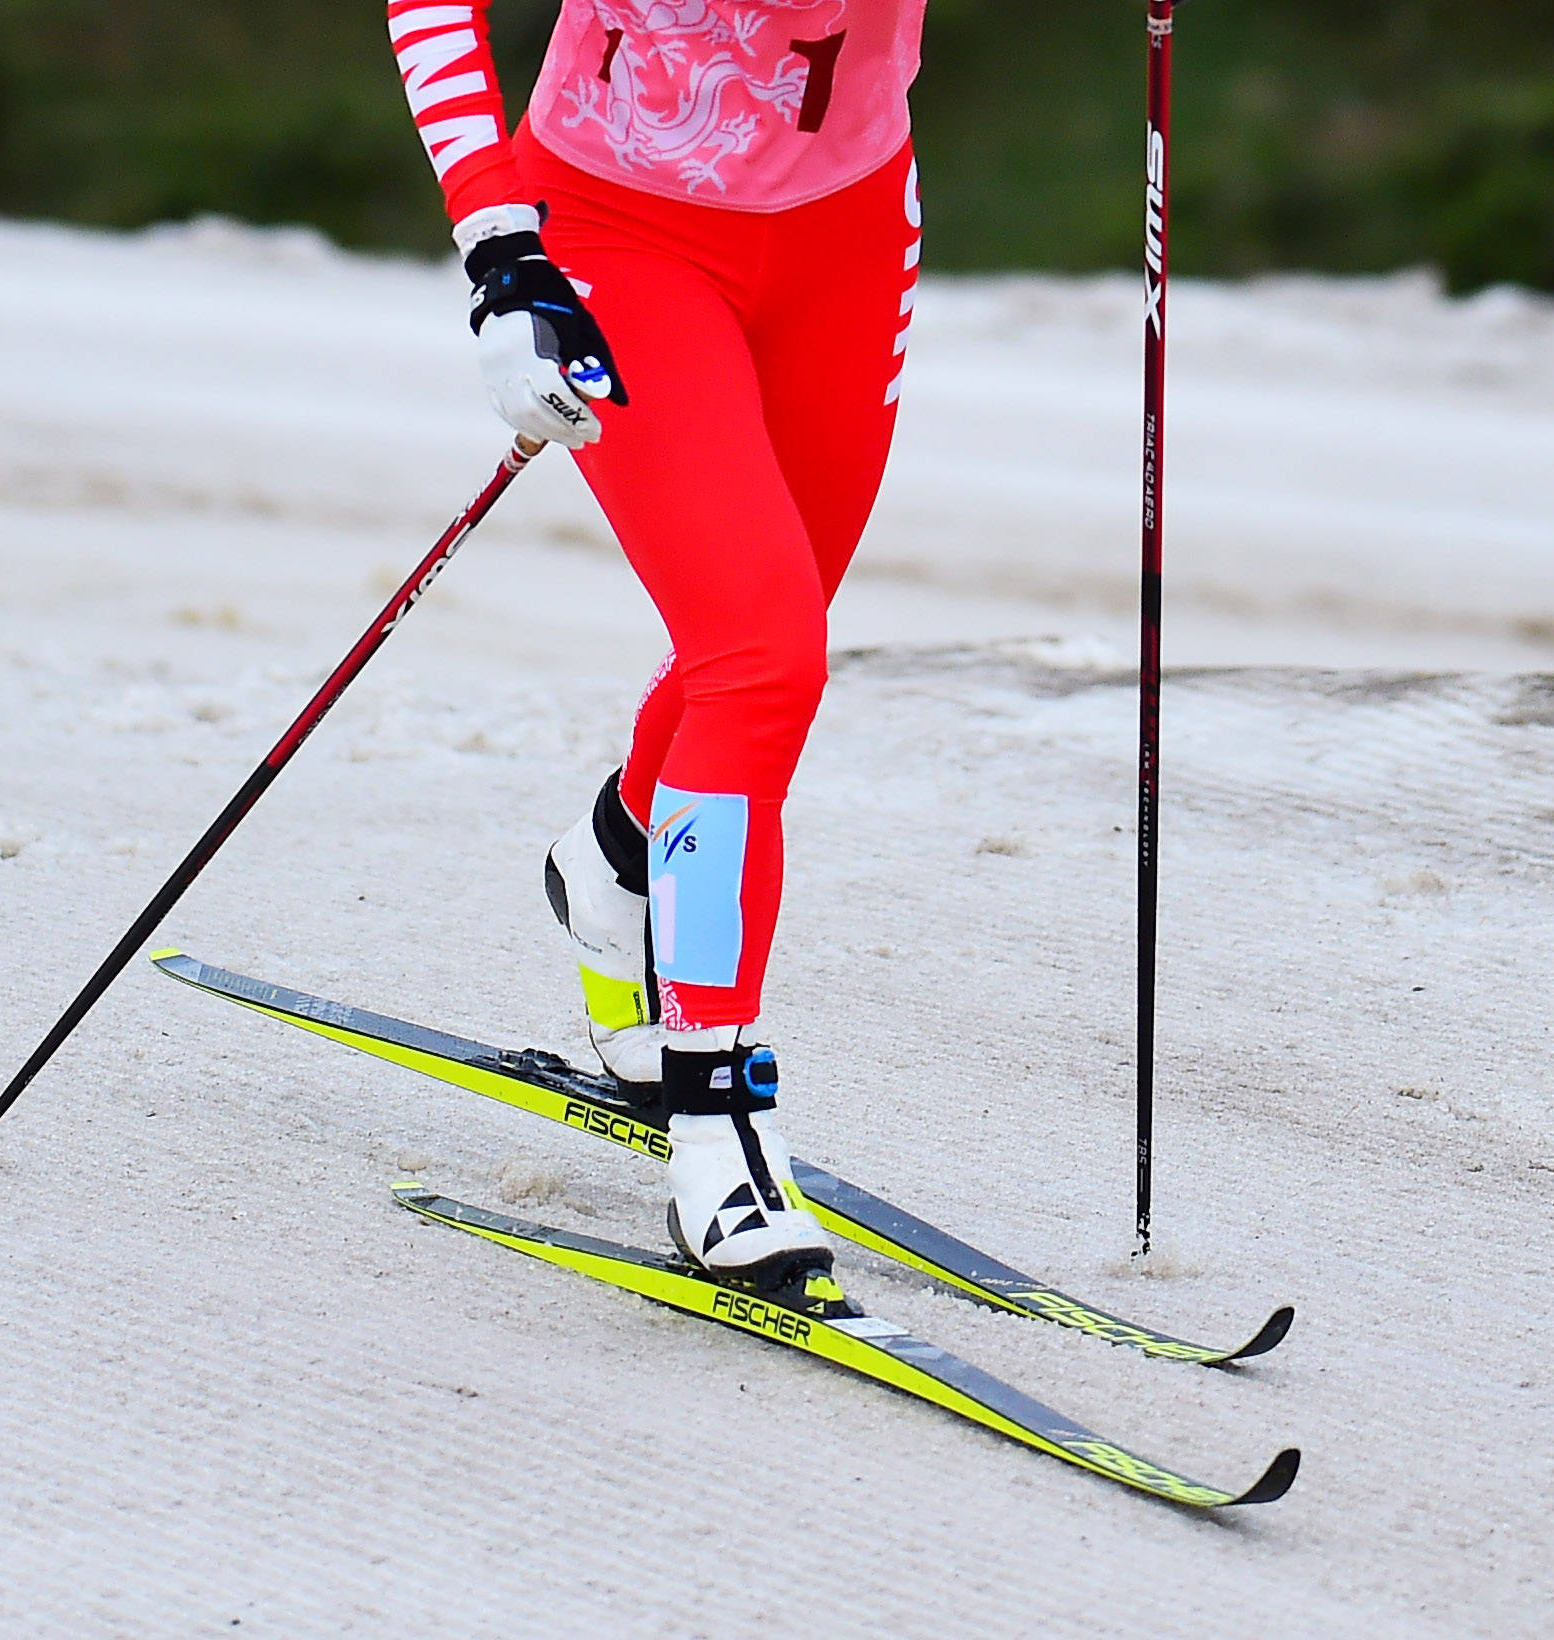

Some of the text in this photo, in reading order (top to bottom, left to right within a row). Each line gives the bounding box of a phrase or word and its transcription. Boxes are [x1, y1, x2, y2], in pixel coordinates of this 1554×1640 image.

[789, 29, 847, 133] 1
[651, 873, 676, 964] 1
[712, 1291, 811, 1346] FISCHER
